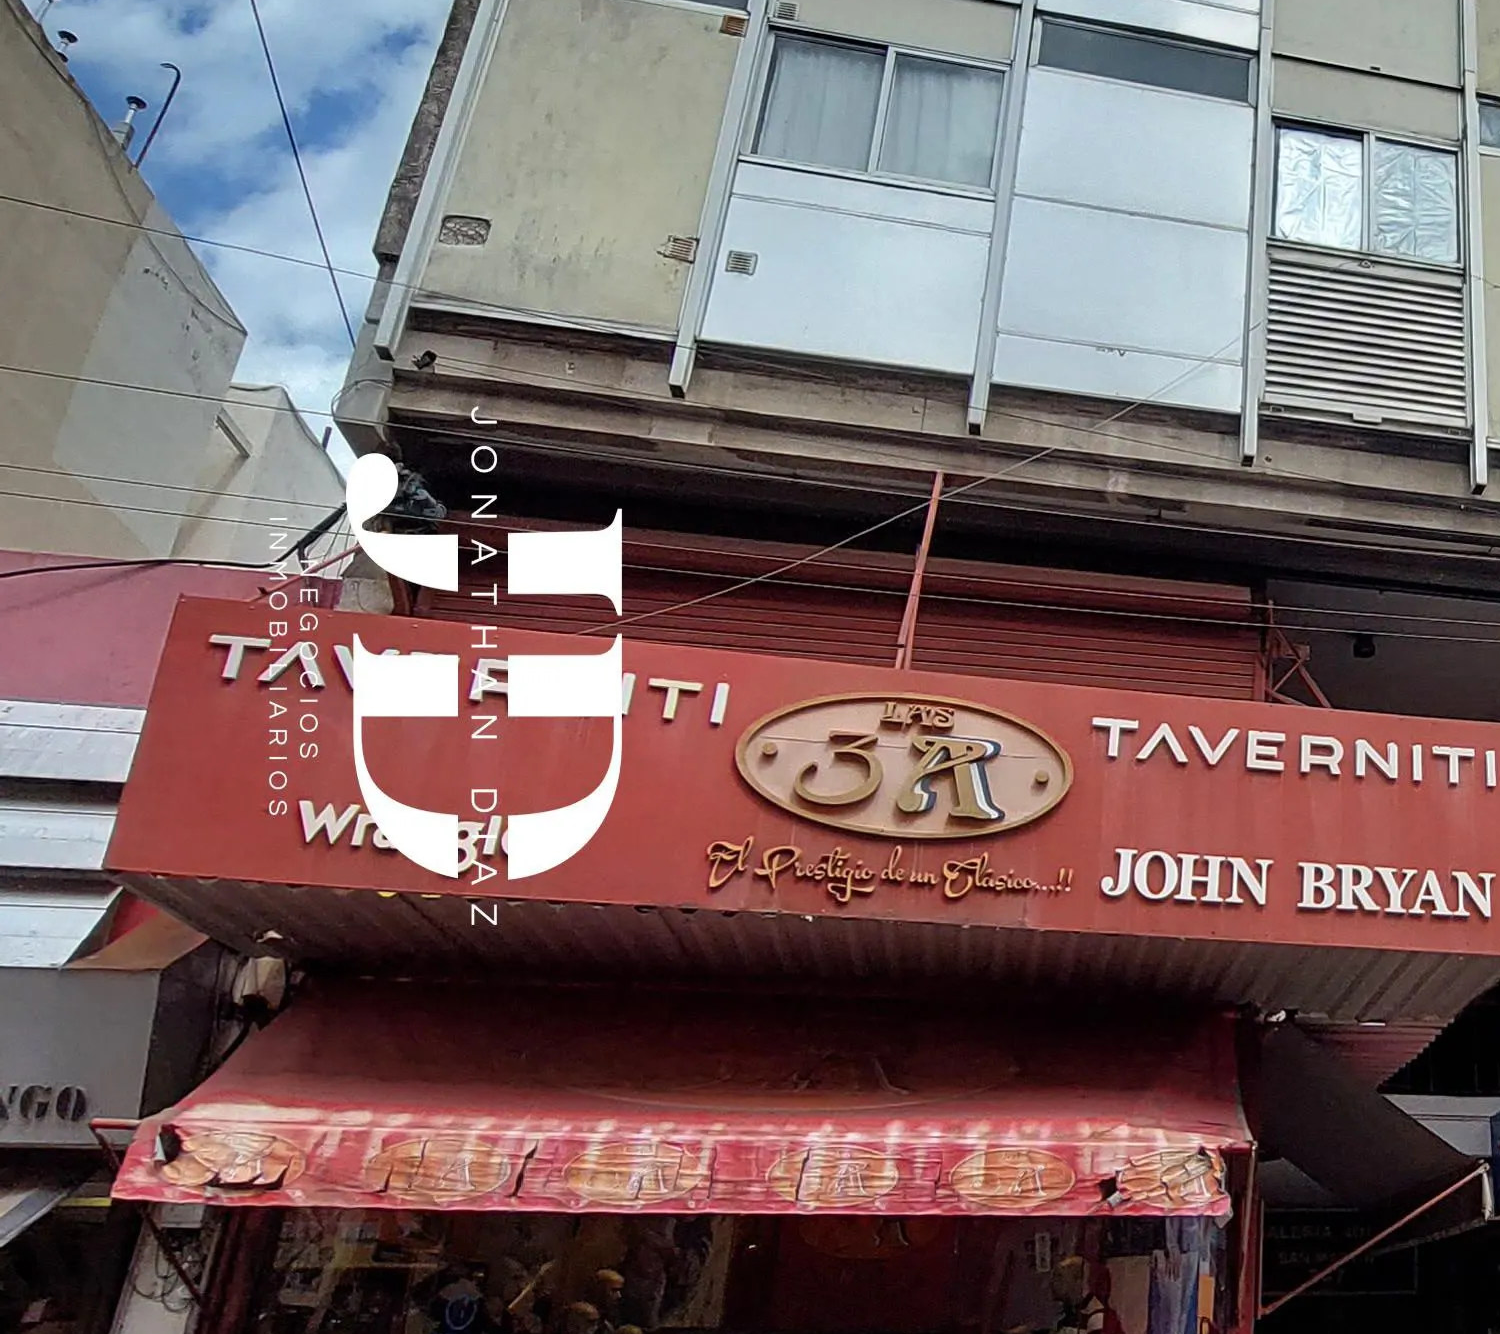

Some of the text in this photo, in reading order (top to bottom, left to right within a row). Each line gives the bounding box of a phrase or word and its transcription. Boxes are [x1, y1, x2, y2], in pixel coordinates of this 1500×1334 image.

[880, 701, 955, 730] LAS
[1092, 717, 1497, 788] TAVERNITI
[706, 836, 755, 889] El
[754, 845, 876, 903] Prestigio
[880, 844, 908, 883] de
[909, 869, 940, 886] un
[1100, 847, 1497, 919] JOHN BRYAN
